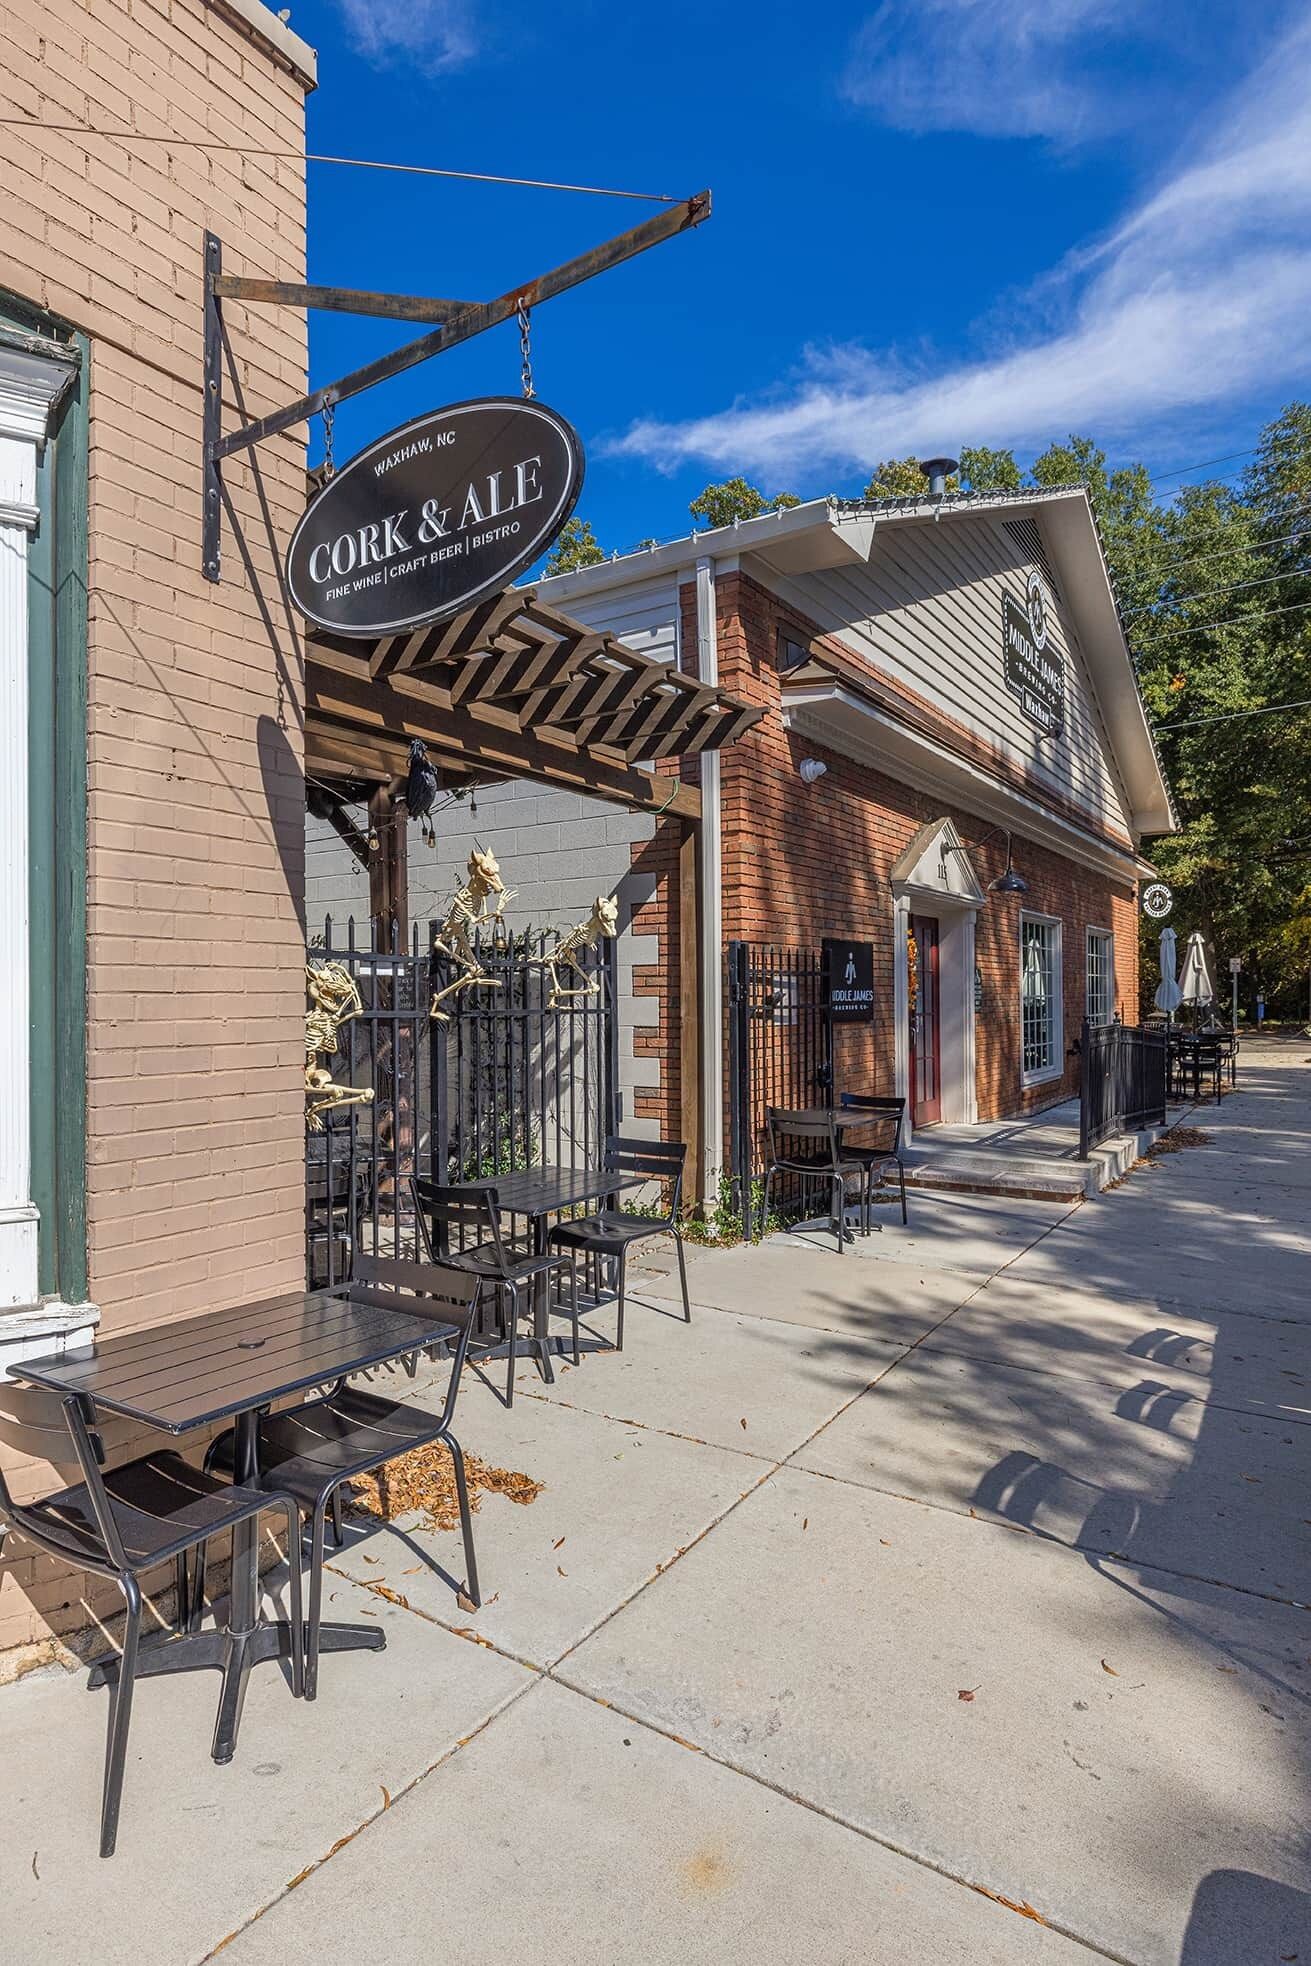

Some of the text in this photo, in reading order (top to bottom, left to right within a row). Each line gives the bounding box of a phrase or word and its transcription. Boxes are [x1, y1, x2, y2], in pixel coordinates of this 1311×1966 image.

[374, 430, 456, 477] WAXHAW, NC
[309, 455, 543, 584] CORK & ALE
[326, 521, 520, 601] FINE WINE CRAFT BEER BISTRO
[1009, 623, 1040, 672] MIDDLE
[1040, 658, 1062, 696] JAMES
[832, 990, 873, 1001] IDDLE JAMES
